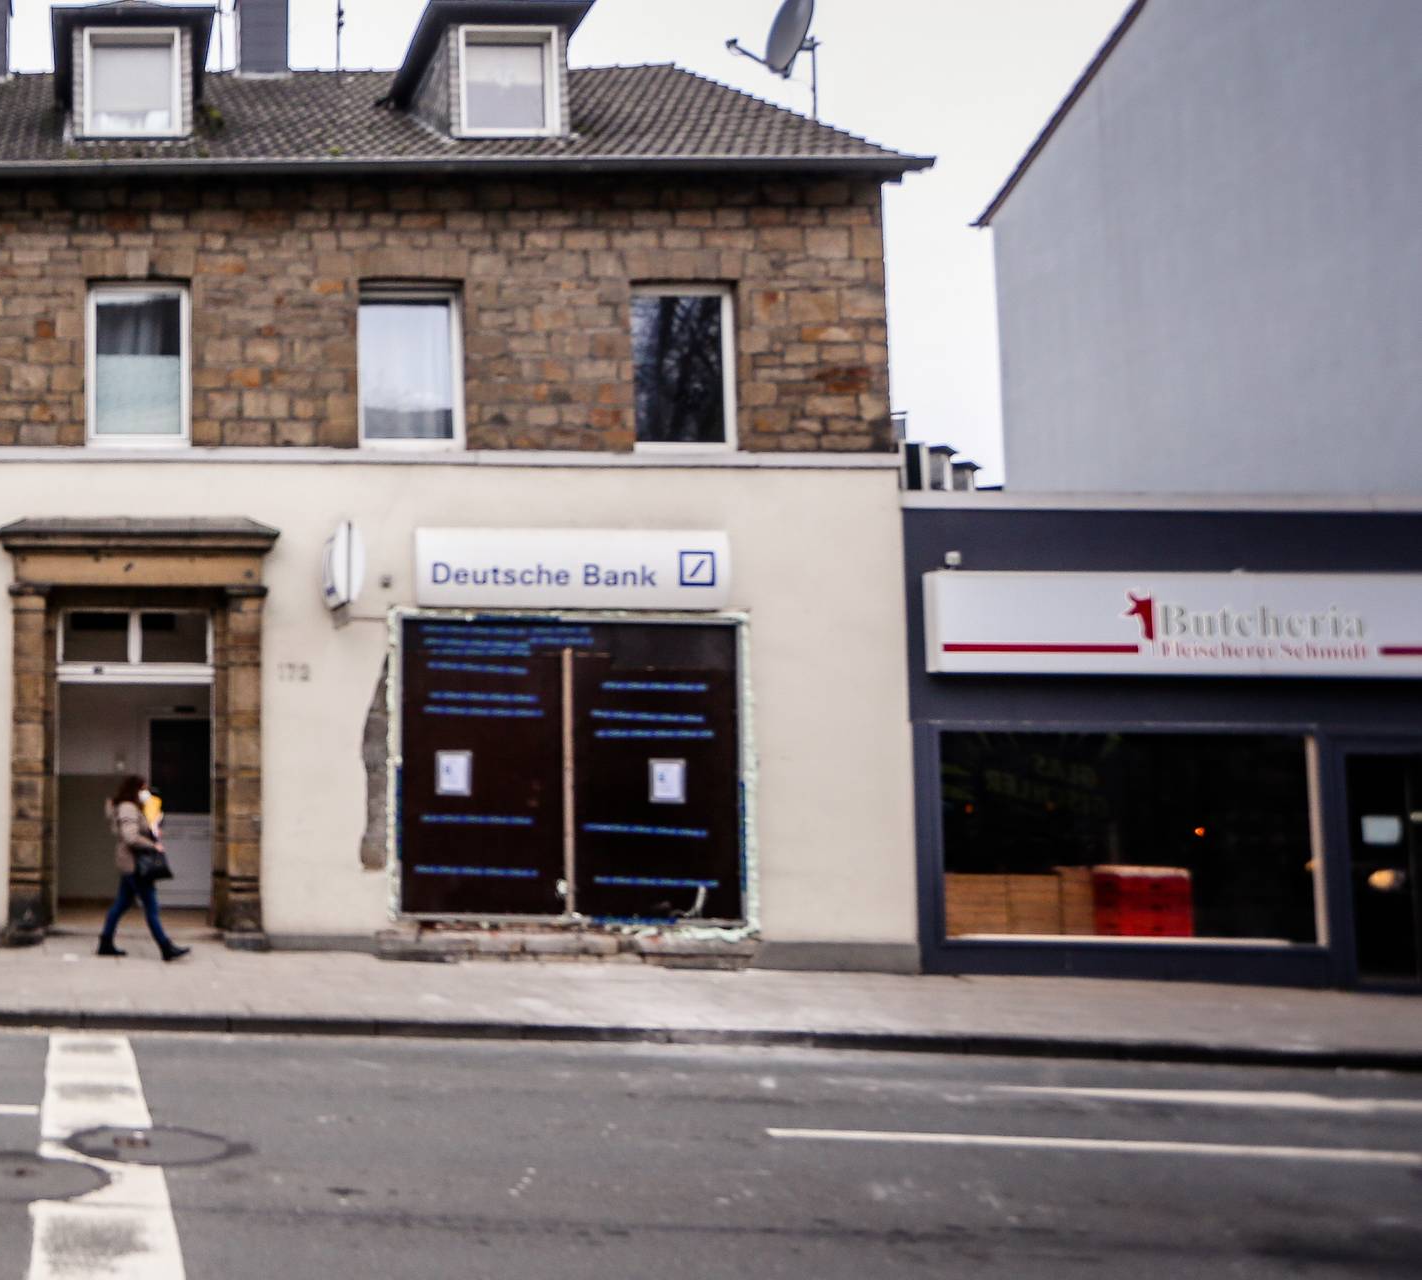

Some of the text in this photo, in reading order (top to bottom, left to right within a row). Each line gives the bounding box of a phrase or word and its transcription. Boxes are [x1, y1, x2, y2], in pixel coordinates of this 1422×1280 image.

[431, 562, 657, 588] Deutsche Bank
[1160, 605, 1365, 639] Butcheria
[1280, 642, 1369, 660] Schmidt
